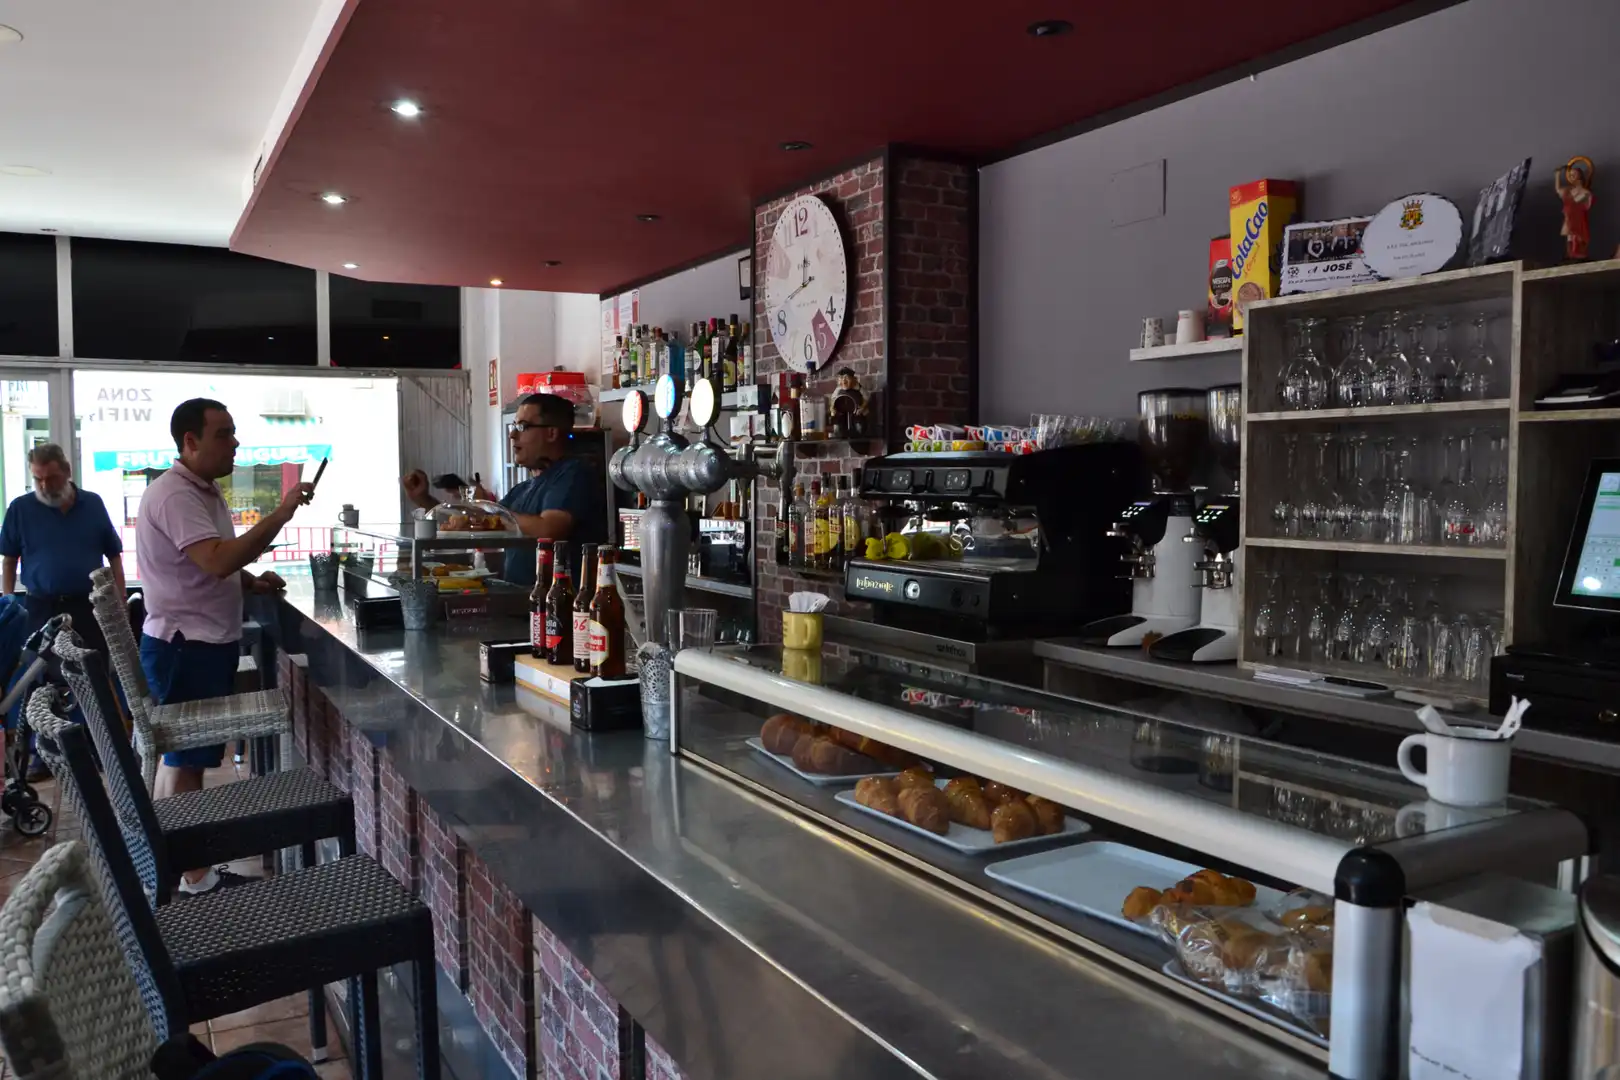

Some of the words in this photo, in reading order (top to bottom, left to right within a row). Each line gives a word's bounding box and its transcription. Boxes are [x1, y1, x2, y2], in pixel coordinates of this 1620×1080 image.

[794, 207, 808, 238] 12
[1322, 260, 1353, 273] JOSÉ
[825, 295, 837, 322] 4
[777, 309, 787, 336] 8
[818, 321, 827, 351] 5
[804, 333, 813, 360] 6
[117, 450, 174, 467] FRUT
[950, 533, 975, 550] S2
[533, 612, 541, 646] AMBAR
